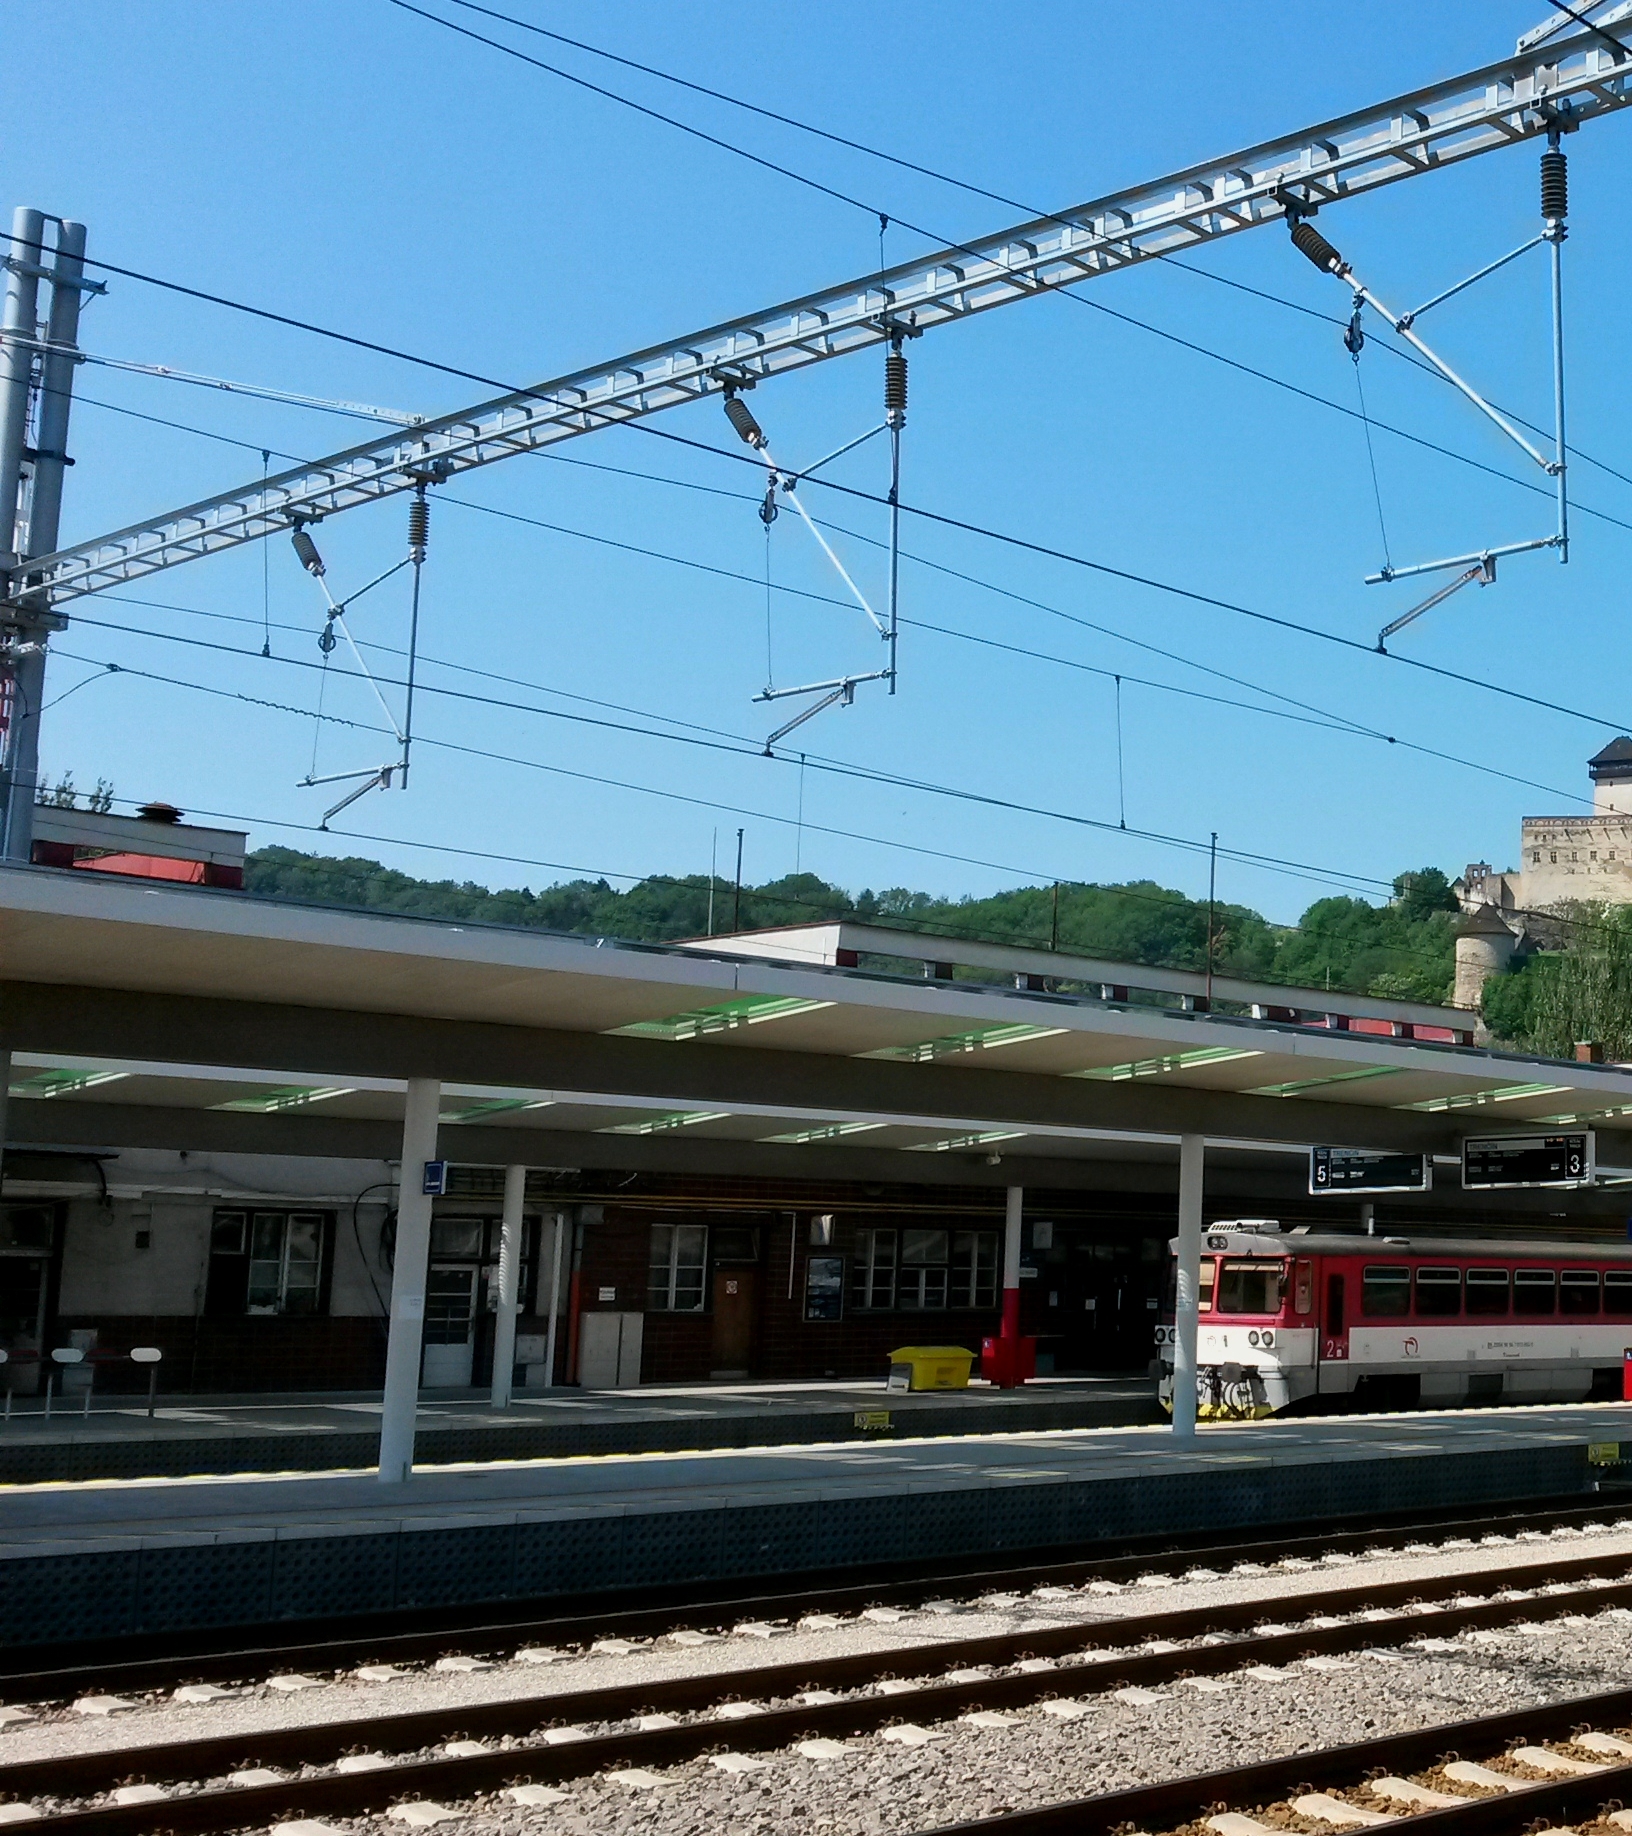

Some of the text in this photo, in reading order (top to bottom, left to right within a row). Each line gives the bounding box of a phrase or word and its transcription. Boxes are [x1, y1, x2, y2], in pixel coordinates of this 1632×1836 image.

[1570, 1154, 1581, 1174] 3
[1317, 1165, 1327, 1182] 5
[1326, 1340, 1334, 1357] 2
